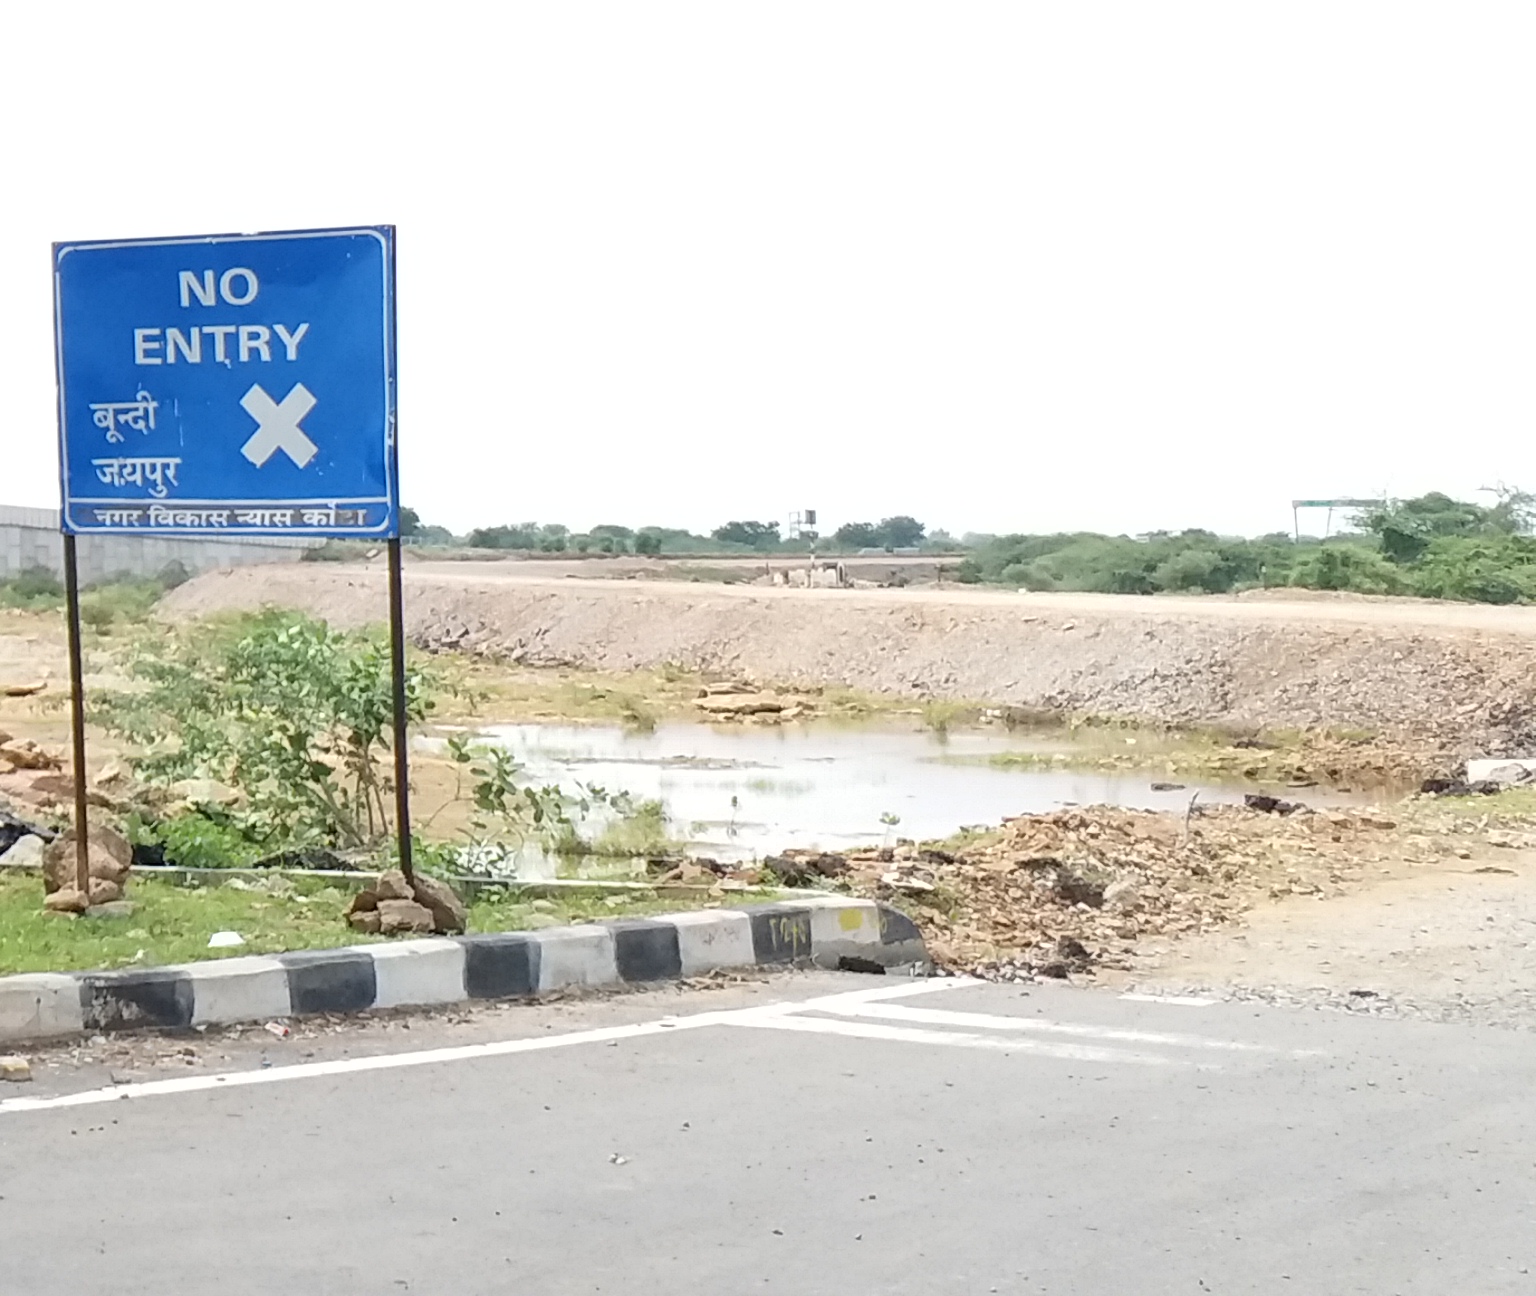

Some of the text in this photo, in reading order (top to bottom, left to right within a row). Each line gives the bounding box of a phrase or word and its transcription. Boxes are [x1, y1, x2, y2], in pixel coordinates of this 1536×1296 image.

[178, 267, 259, 308] NO
[133, 323, 310, 365] ENTRY
[88, 390, 159, 443] बून्दी
[90, 457, 182, 498] जयपुर
[93, 508, 142, 526] नगर
[148, 505, 231, 528] विकास
[234, 508, 294, 527] न्यास
